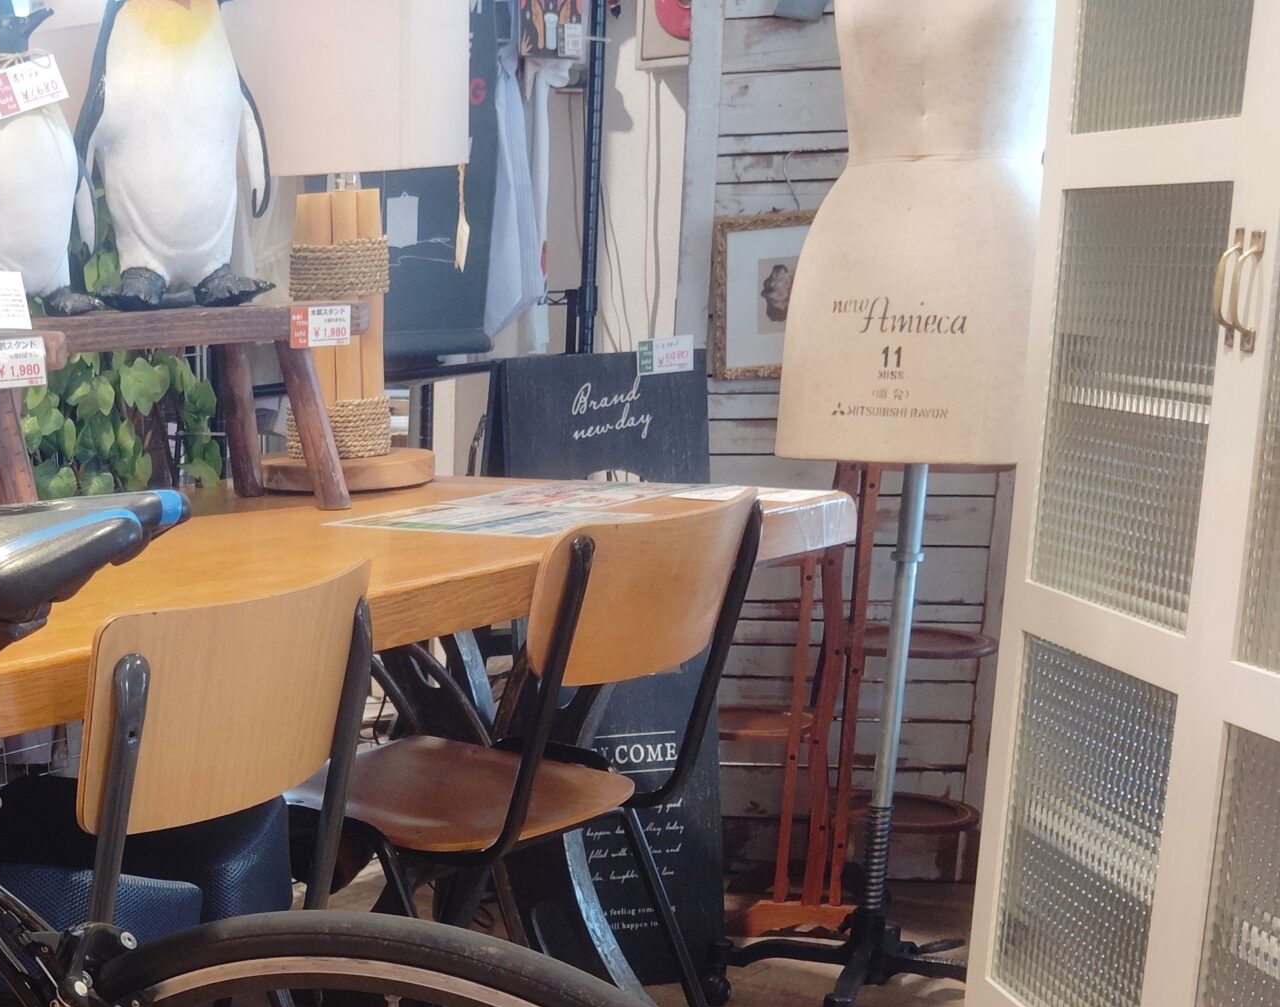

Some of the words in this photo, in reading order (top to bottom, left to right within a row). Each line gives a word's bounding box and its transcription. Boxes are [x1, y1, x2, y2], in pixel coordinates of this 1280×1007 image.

[832, 299, 869, 314] new
[881, 346, 902, 368] 11
[571, 375, 641, 415] Brand
[572, 423, 614, 440] new
[616, 402, 653, 439] day
[846, 405, 907, 418] MITSUBISHI
